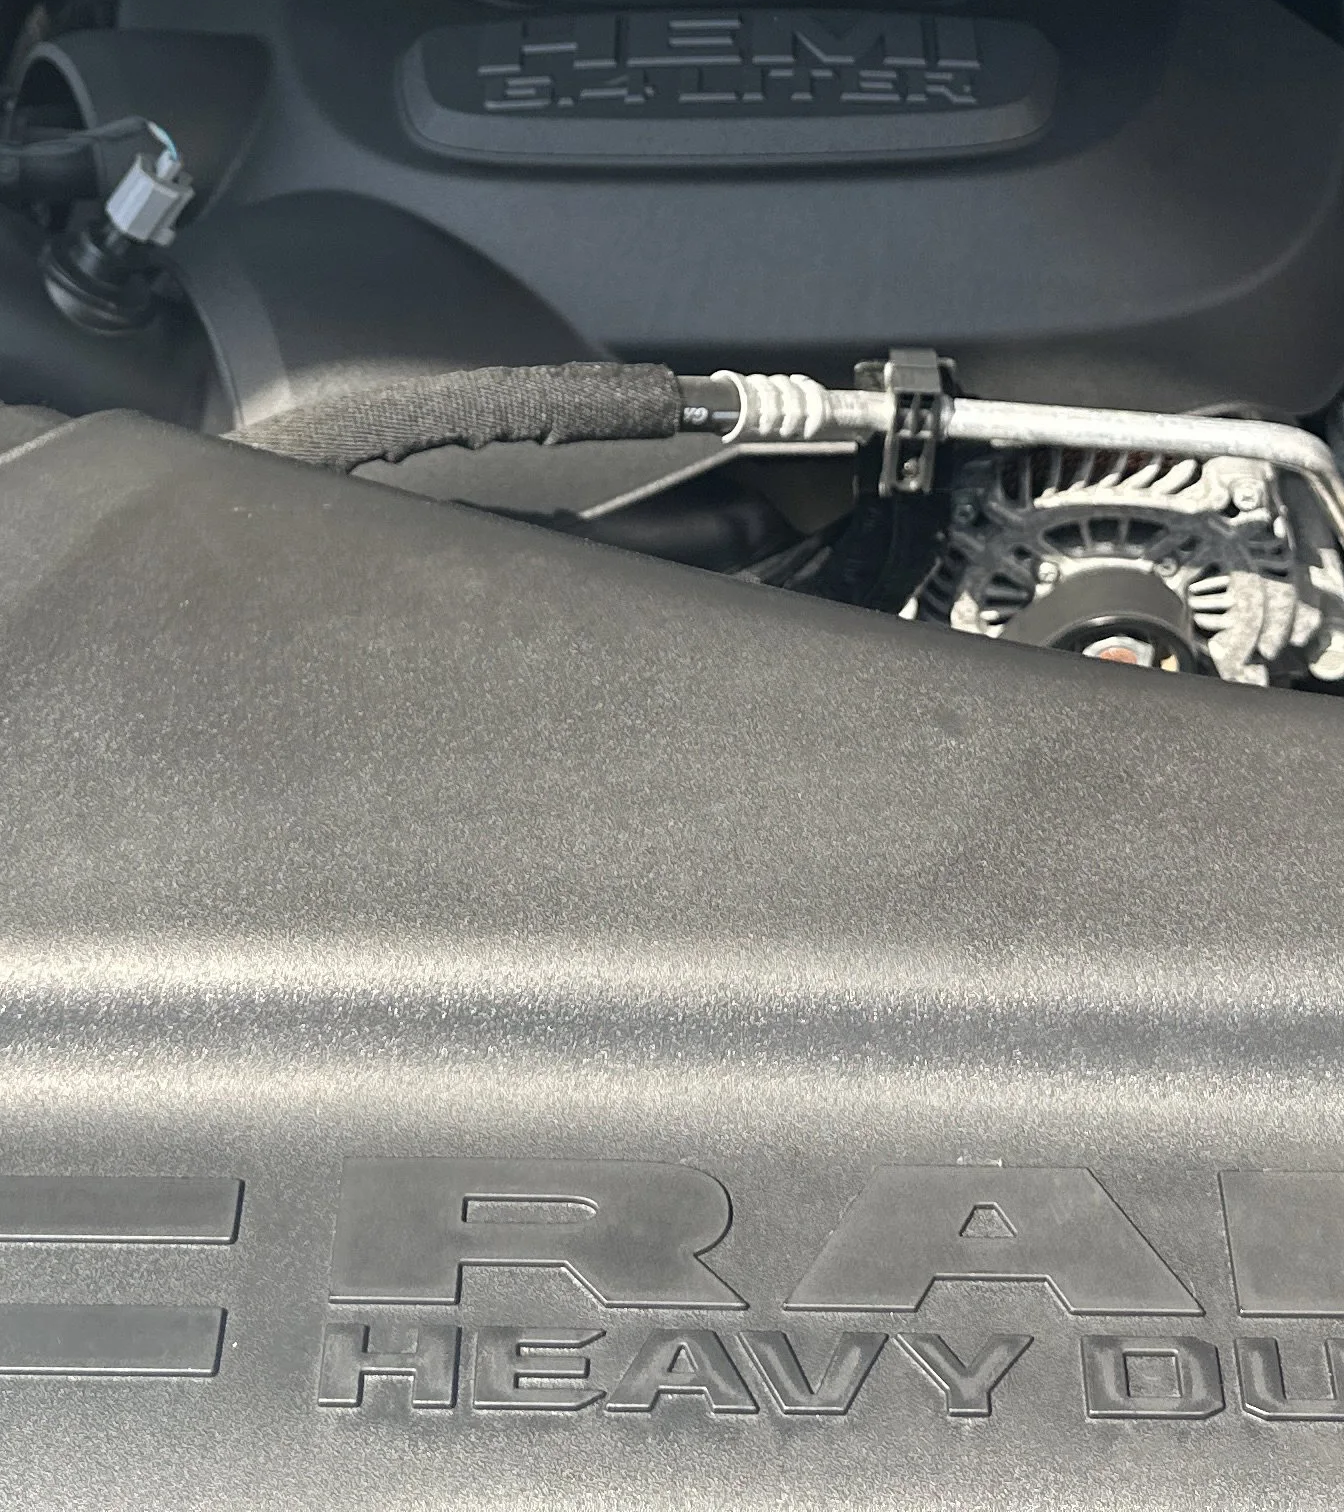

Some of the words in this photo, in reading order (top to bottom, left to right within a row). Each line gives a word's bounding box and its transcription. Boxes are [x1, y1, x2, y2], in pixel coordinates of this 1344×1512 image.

[477, 13, 981, 75] HEMI
[677, 64, 979, 106] LITER
[317, 1324, 1035, 1418] HEAVY
